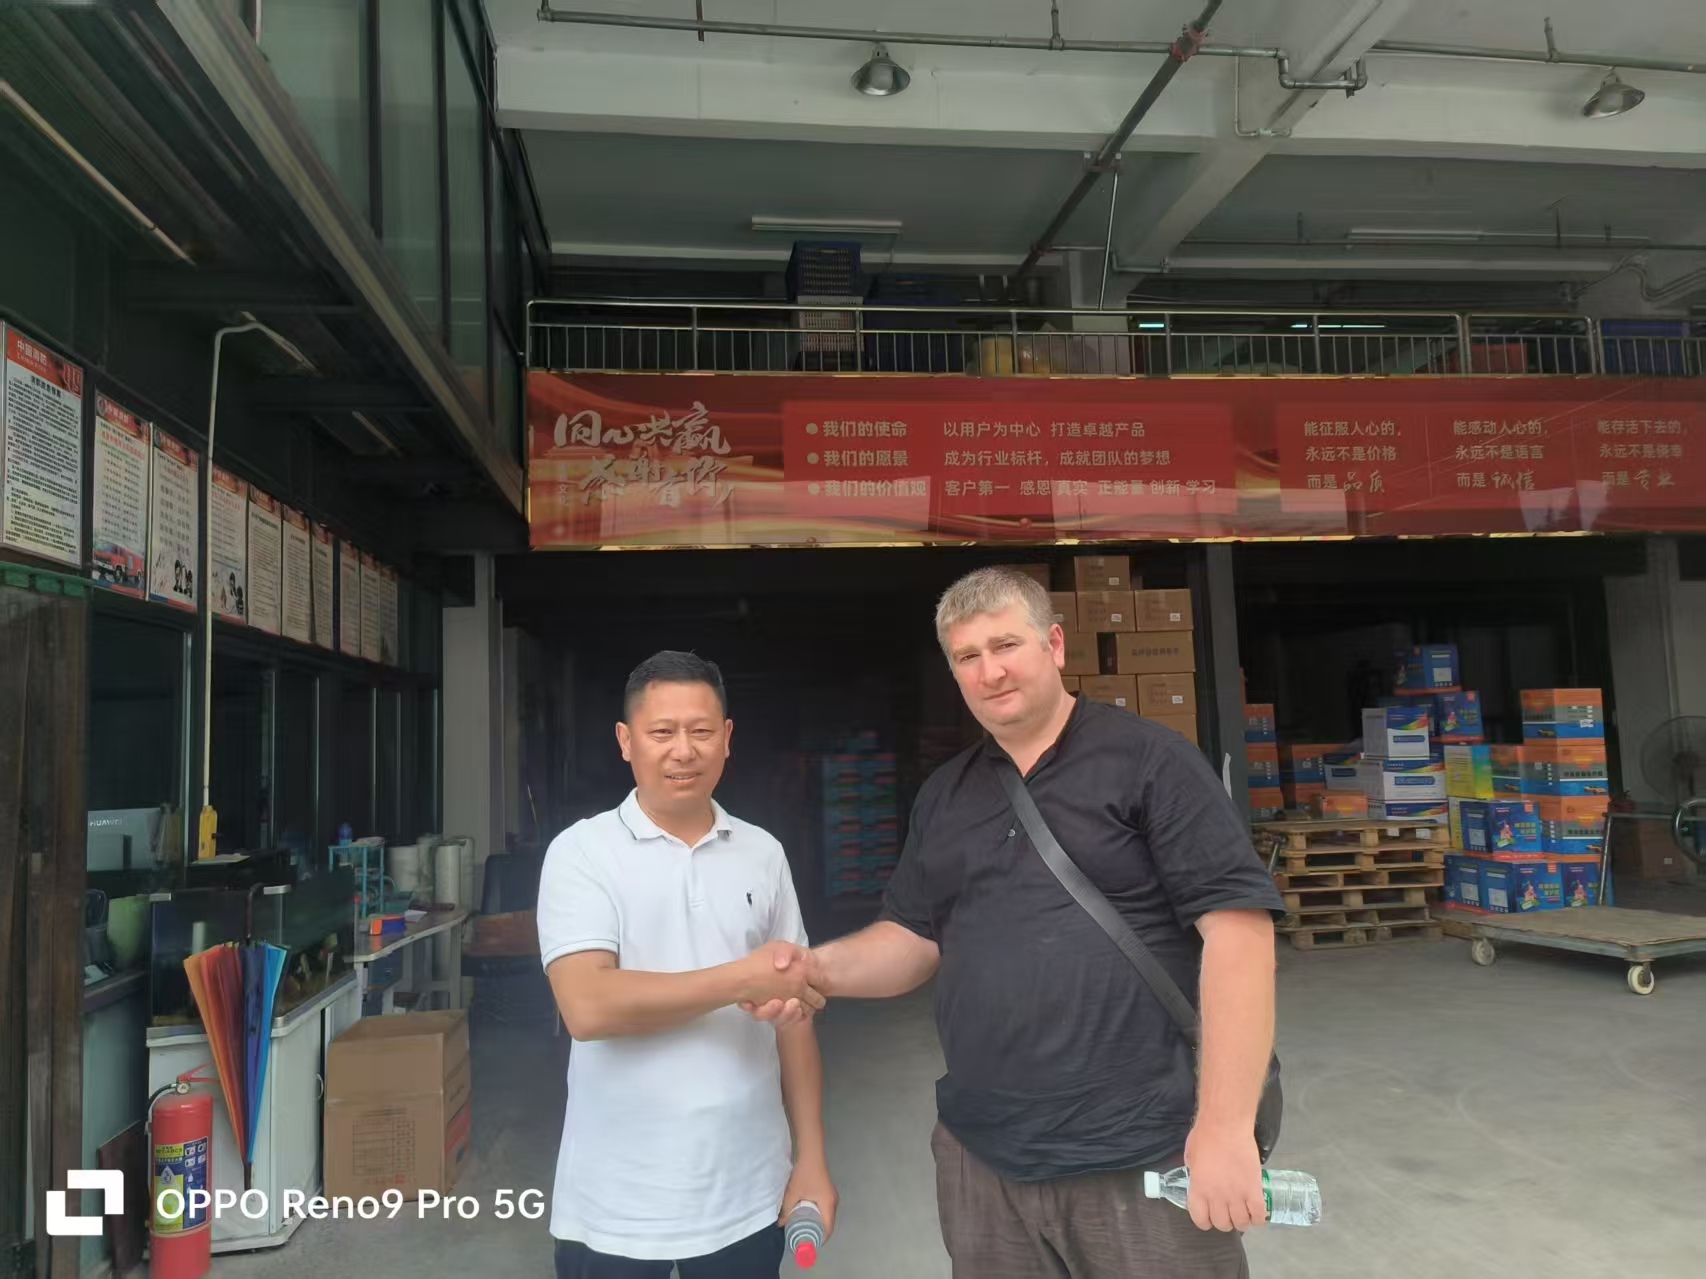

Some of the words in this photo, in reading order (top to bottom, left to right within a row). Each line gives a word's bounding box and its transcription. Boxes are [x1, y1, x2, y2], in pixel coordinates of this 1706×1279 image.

[554, 400, 732, 456] 同心共赢
[823, 420, 908, 437] 我们的使命
[943, 421, 1041, 438] 以用户为中心
[1050, 421, 1146, 438] 打造卓越产品
[824, 450, 909, 467] 我们的愿景
[1306, 445, 1398, 462] 永远不是价格
[1456, 445, 1544, 461] 永远不是语言
[824, 480, 927, 498] 我们的价值观
[945, 480, 1010, 497] 客户第一
[1020, 480, 1052, 497] 感恩
[1056, 480, 1088, 496] 真实
[1098, 480, 1144, 496] 正能量
[1150, 480, 1180, 496] 创新
[1186, 480, 1216, 496] 学习
